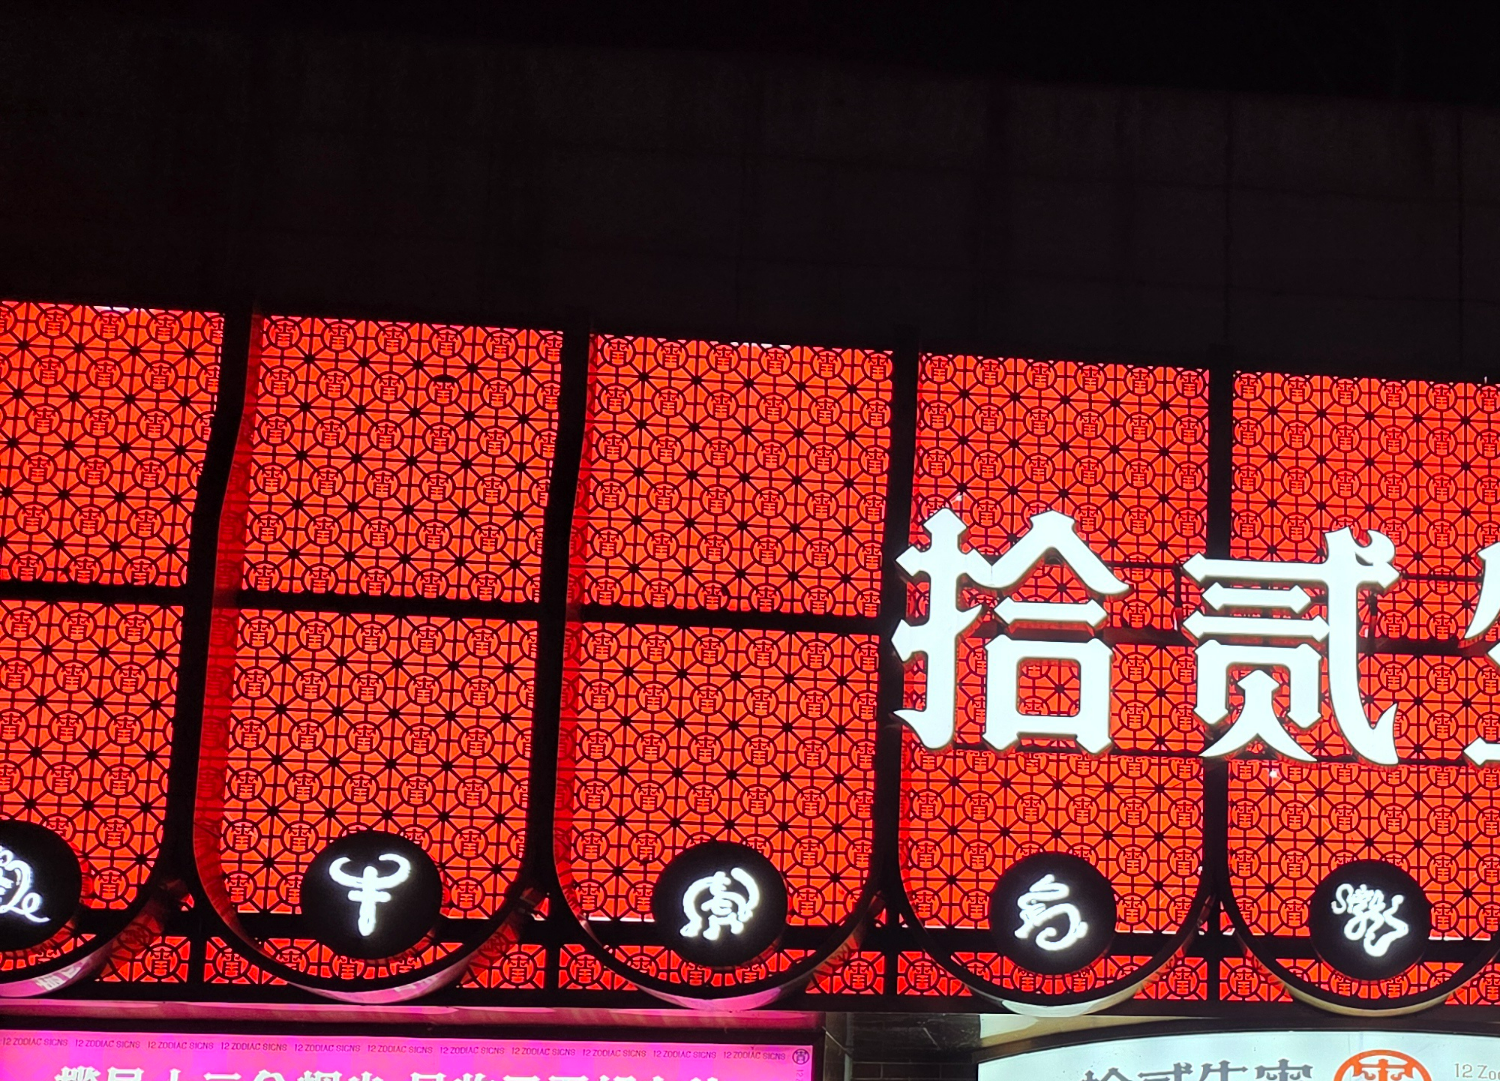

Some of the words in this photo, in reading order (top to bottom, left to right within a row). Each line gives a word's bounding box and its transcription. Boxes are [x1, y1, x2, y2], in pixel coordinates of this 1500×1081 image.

[2, 1037, 12, 1047] 12
[12, 1037, 43, 1047] ZODIAC
[75, 1039, 84, 1048] 12
[84, 1039, 115, 1049] ZODIAC
[147, 1040, 157, 1049] 12
[157, 1040, 188, 1050] ZODIAC
[220, 1041, 230, 1051] 12
[230, 1041, 261, 1051] ZODIAC
[294, 1043, 304, 1052] 12
[304, 1043, 335, 1053] ZODIAC
[367, 1044, 377, 1053] 12
[377, 1044, 408, 1054] ZODIAC
[439, 1045, 449, 1055] 12
[449, 1046, 480, 1055] ZODIAC
[511, 1047, 521, 1056] 12
[521, 1047, 551, 1057] ZODIAC
[582, 1048, 592, 1057] 12
[592, 1048, 622, 1058] ZODIAC
[653, 1049, 662, 1059] 12
[662, 1049, 692, 1059] ZODIAC
[723, 1051, 732, 1060] 12
[732, 1051, 762, 1061] ZODIAC
[1455, 1063, 1473, 1079] 12
